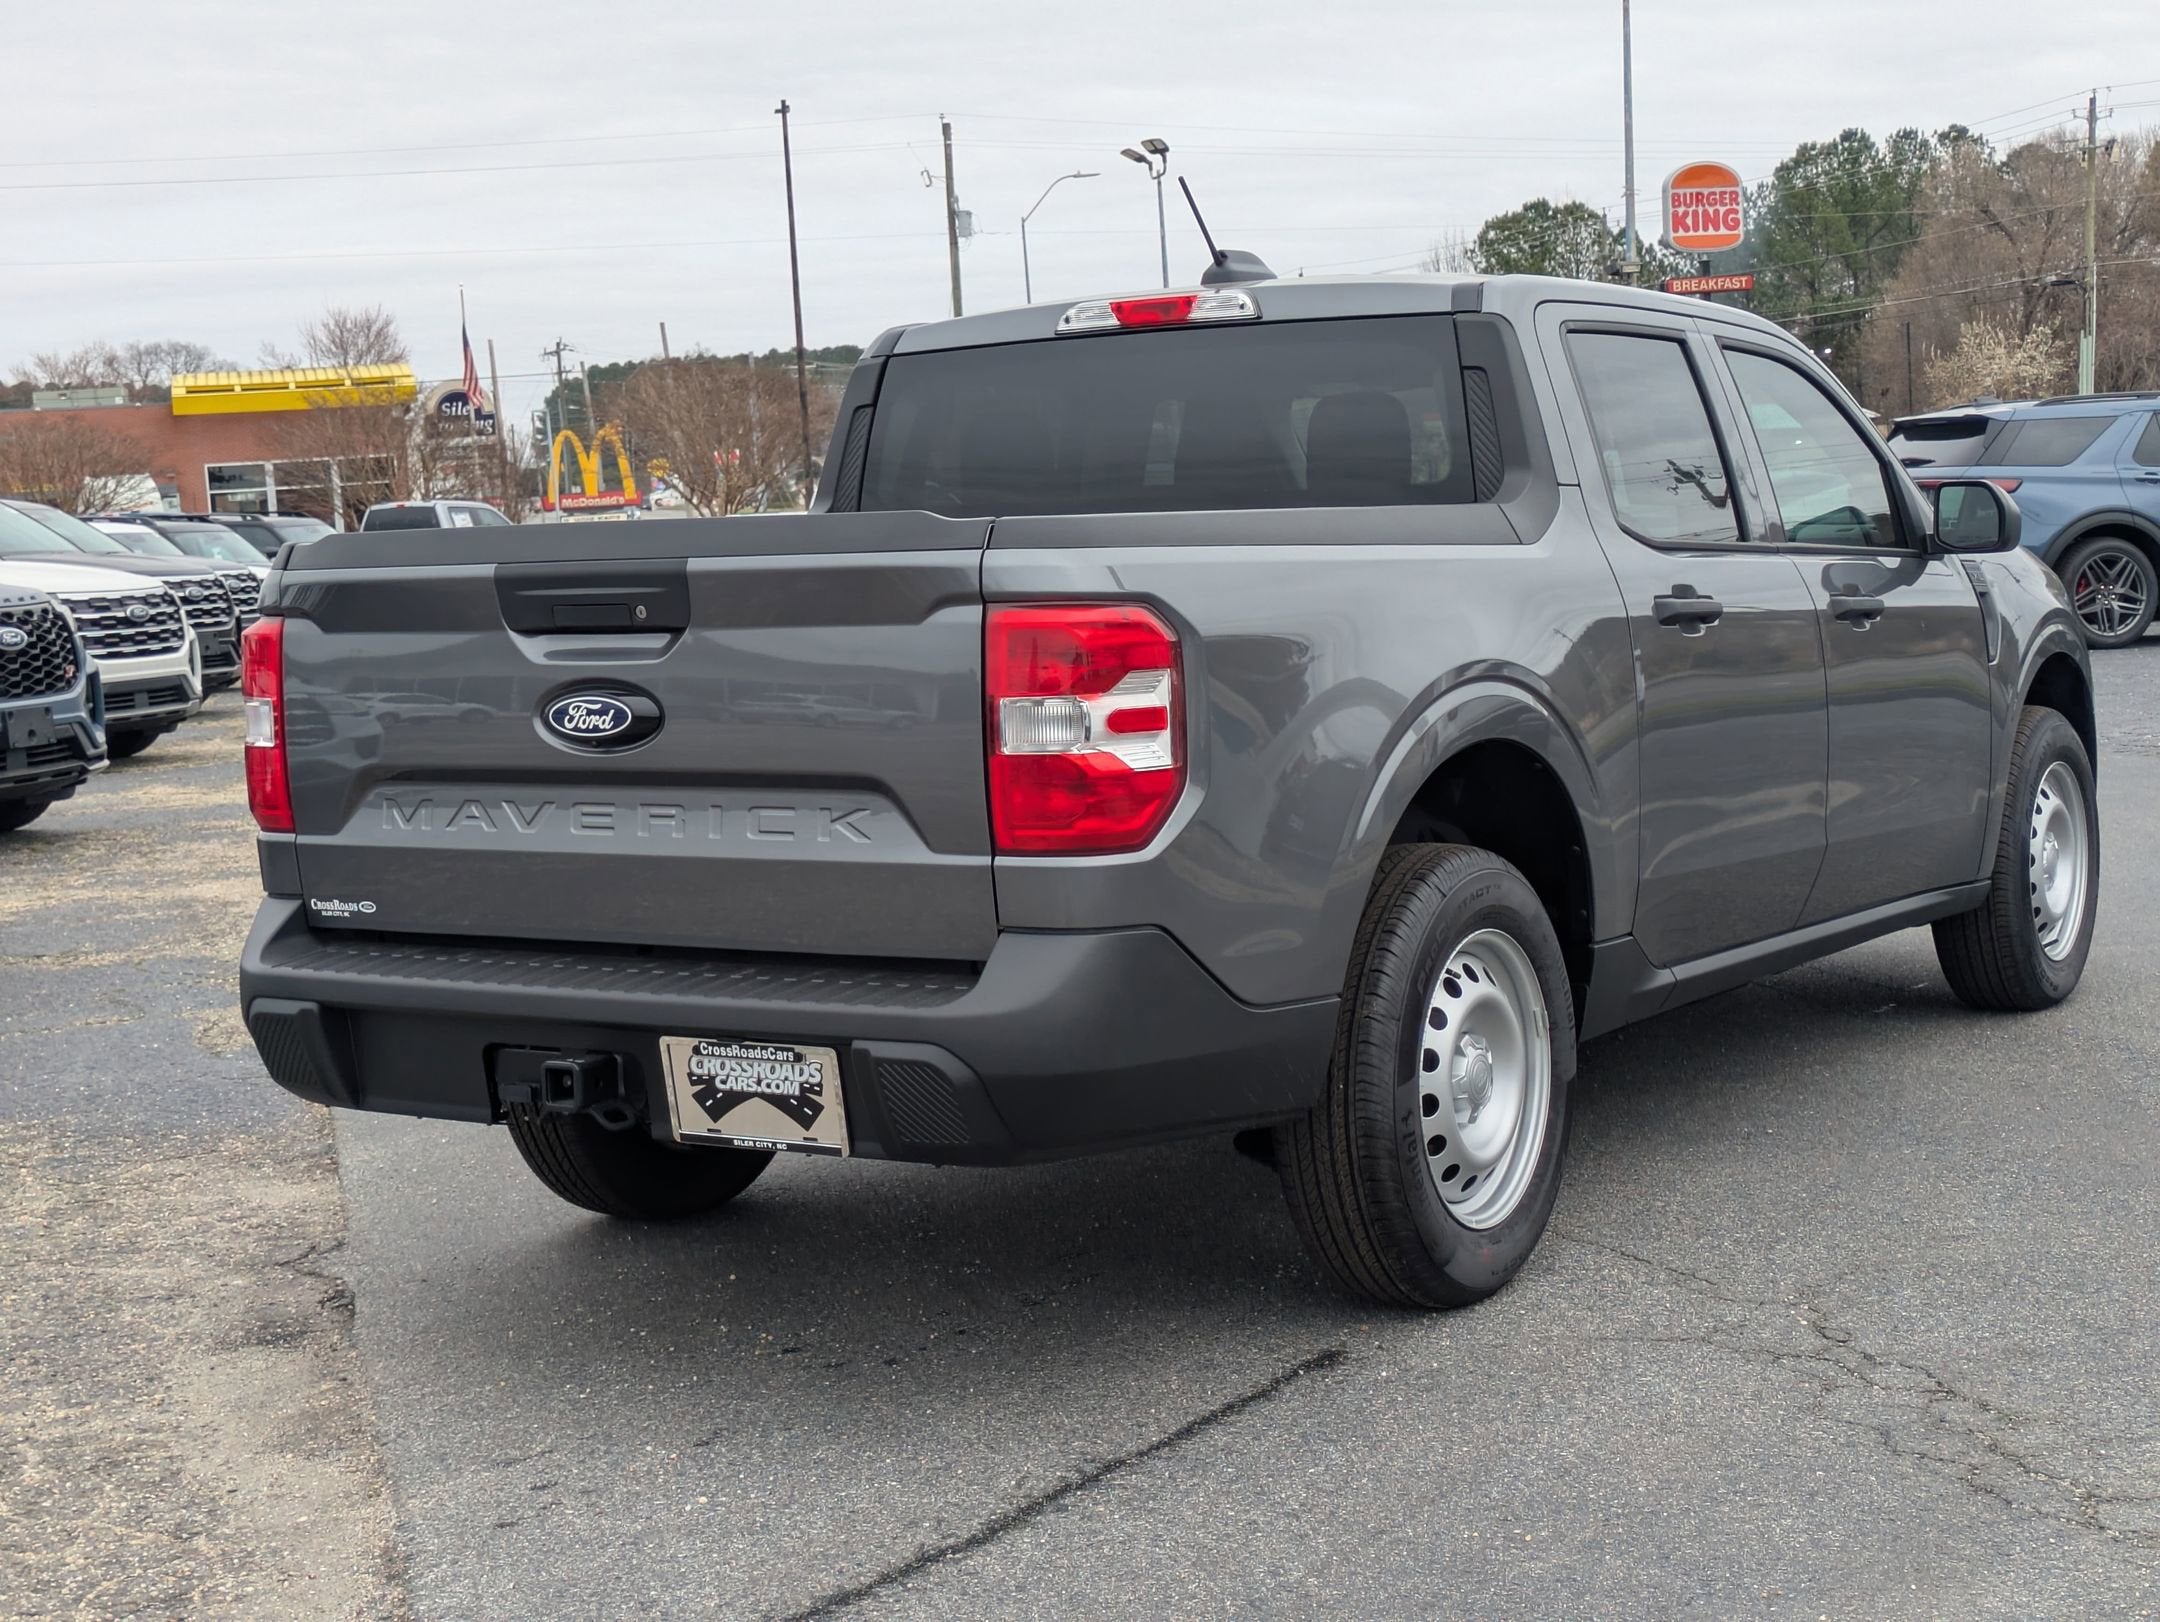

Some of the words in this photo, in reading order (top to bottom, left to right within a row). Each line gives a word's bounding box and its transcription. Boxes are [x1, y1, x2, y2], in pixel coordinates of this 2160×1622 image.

[1671, 190, 1740, 209] BURGER
[1671, 208, 1741, 233] KING
[1672, 276, 1748, 293] BREAKFAST
[441, 400, 472, 417] Sile
[561, 496, 625, 508] McDonald's
[564, 702, 615, 730] Ford
[382, 797, 873, 844] MAVERICK
[700, 1042, 794, 1062] CrossRoadsCars
[689, 1055, 823, 1084] CROSSROADS
[715, 1075, 801, 1097] CARS.COM
[733, 1139, 754, 1147] SILER
